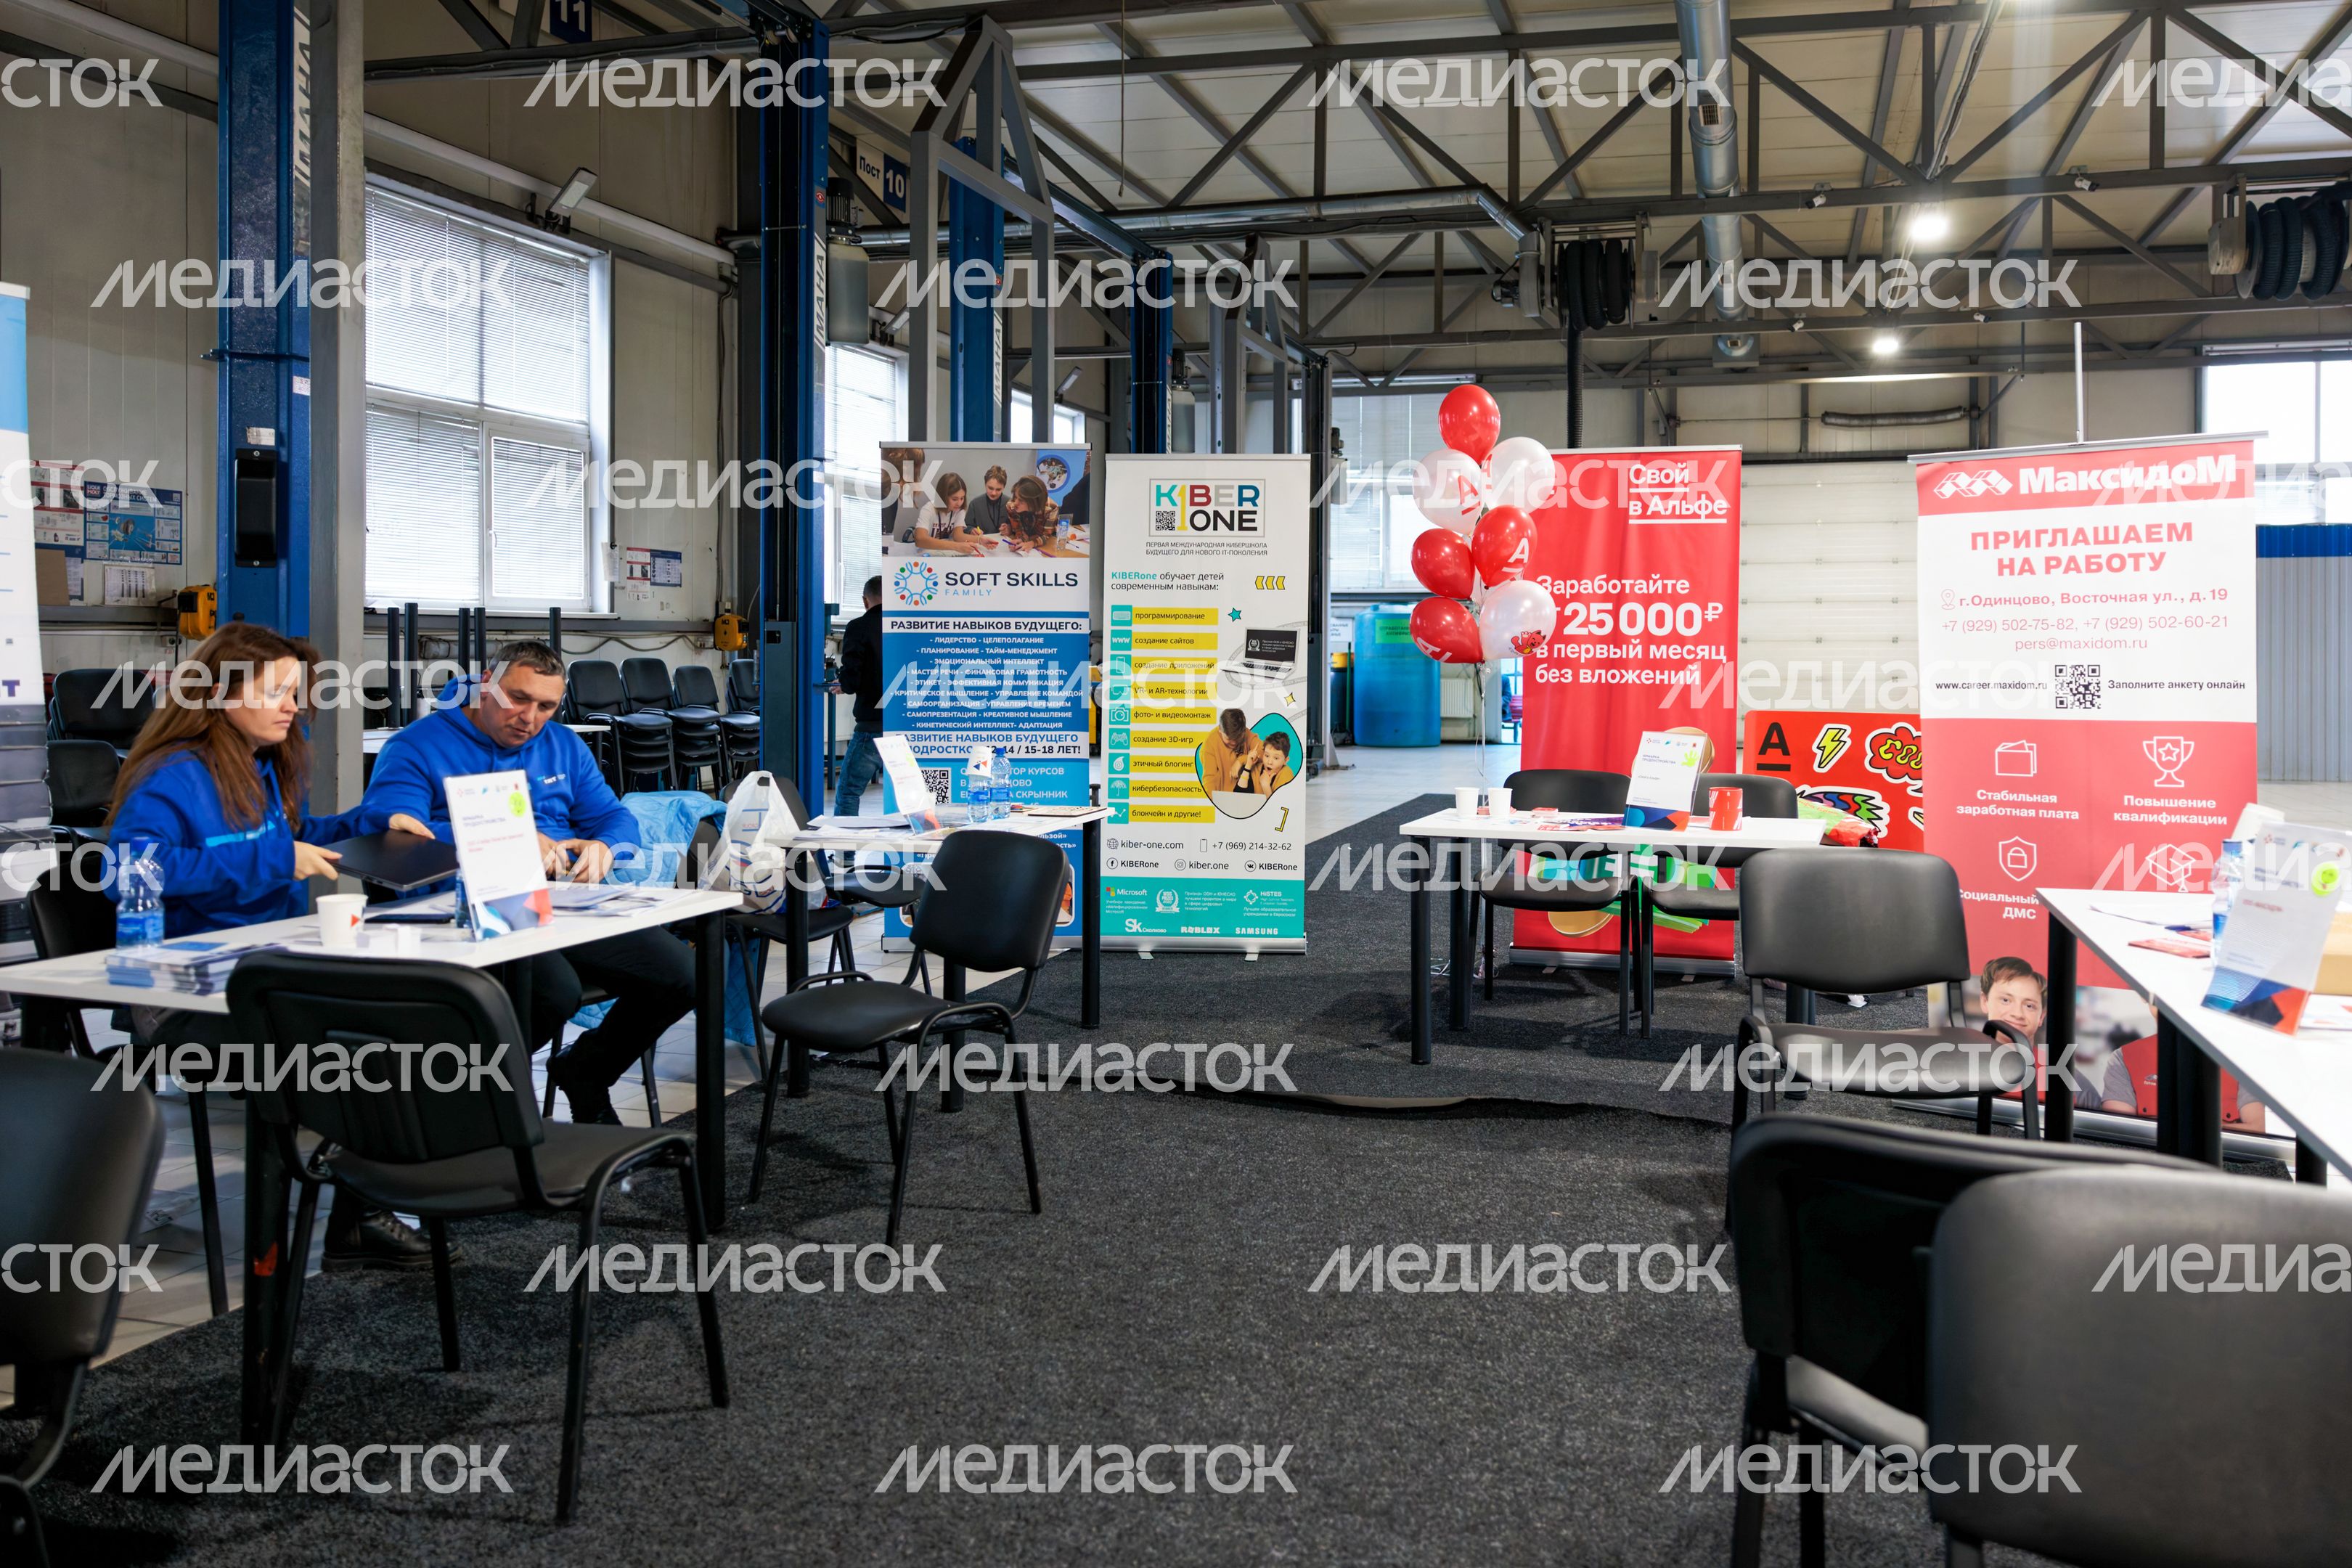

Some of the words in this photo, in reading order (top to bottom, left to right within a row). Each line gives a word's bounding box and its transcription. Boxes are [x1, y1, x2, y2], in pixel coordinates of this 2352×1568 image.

[859, 155, 881, 180] Пост
[886, 169, 905, 198] 10
[815, 253, 825, 339] MAHA
[1629, 462, 1689, 484] Свой
[1629, 499, 1642, 515] в
[1647, 494, 1728, 521] Альфе
[1189, 510, 1257, 531] ONE
[1970, 522, 2194, 551] ПРИГЛАШАЕМ
[1997, 558, 2037, 576] НА
[2044, 552, 2166, 576] РАБОТУ
[945, 572, 1001, 587] SOFT
[1007, 573, 1078, 587] SKILLS
[1111, 571, 1157, 580] KIBERone
[1159, 573, 1196, 582] обучает
[1198, 571, 1224, 581] детей
[1536, 573, 1690, 598] Заработайте
[2060, 590, 2148, 605] Восточная
[891, 621, 950, 629] РАЗВИТИЕ
[1016, 621, 1082, 632] БУДУЩЕГО:
[1941, 620, 1958, 632] +7
[1961, 618, 1998, 633] (929)
[2001, 618, 2078, 632] 502-75-82,
[2083, 618, 2100, 629] +7
[2104, 616, 2143, 631] (929)
[2148, 614, 2228, 629] 502-60-21
[1536, 645, 1548, 658] в
[1553, 639, 1643, 663] первый
[1649, 644, 1726, 663] месяц
[2015, 638, 2147, 653] pers@maxidom.ru
[1535, 663, 1572, 684] без
[1579, 664, 1700, 685] вложений
[1935, 679, 2048, 691] www.career.maxidom.ru
[2107, 679, 2164, 690] Заполните
[2168, 680, 2204, 690] анкету
[2206, 679, 2245, 690] онлайн
[1016, 735, 1078, 743] БУДУЩЕГО
[1028, 767, 1064, 777] КУРСОВ
[1976, 789, 2057, 804] Стабильная
[2123, 795, 2216, 809] Повышение
[1956, 804, 2035, 820] заработная
[2038, 808, 2080, 820] плата
[2113, 812, 2227, 825] квалификации
[1121, 840, 1184, 849] kiber-one.com
[1225, 841, 1246, 851] (969)
[1189, 861, 1229, 870] kiber.one
[2002, 907, 2036, 921] ДМС
[1125, 918, 1143, 932] Sk
